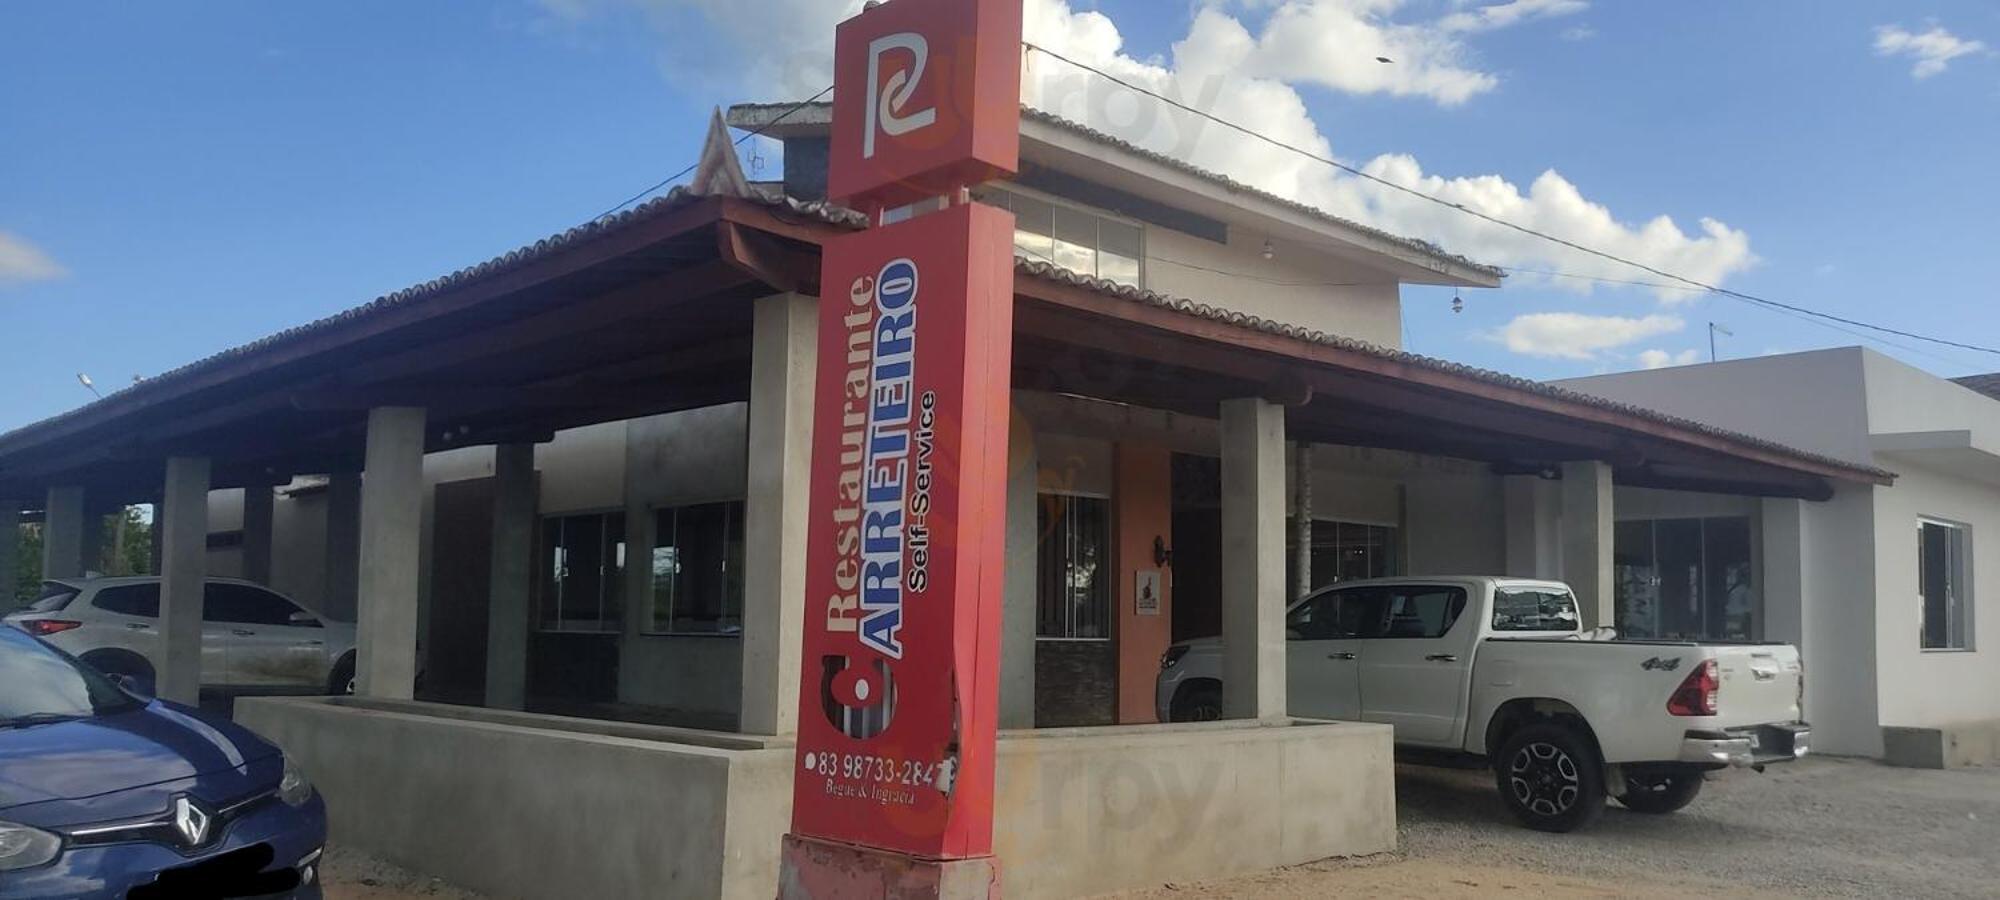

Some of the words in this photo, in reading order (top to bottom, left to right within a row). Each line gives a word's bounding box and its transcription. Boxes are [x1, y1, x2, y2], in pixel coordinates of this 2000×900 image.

[826, 274, 875, 632] Restaurante
[908, 390, 936, 593] Self-Service
[818, 752, 838, 777] 83
